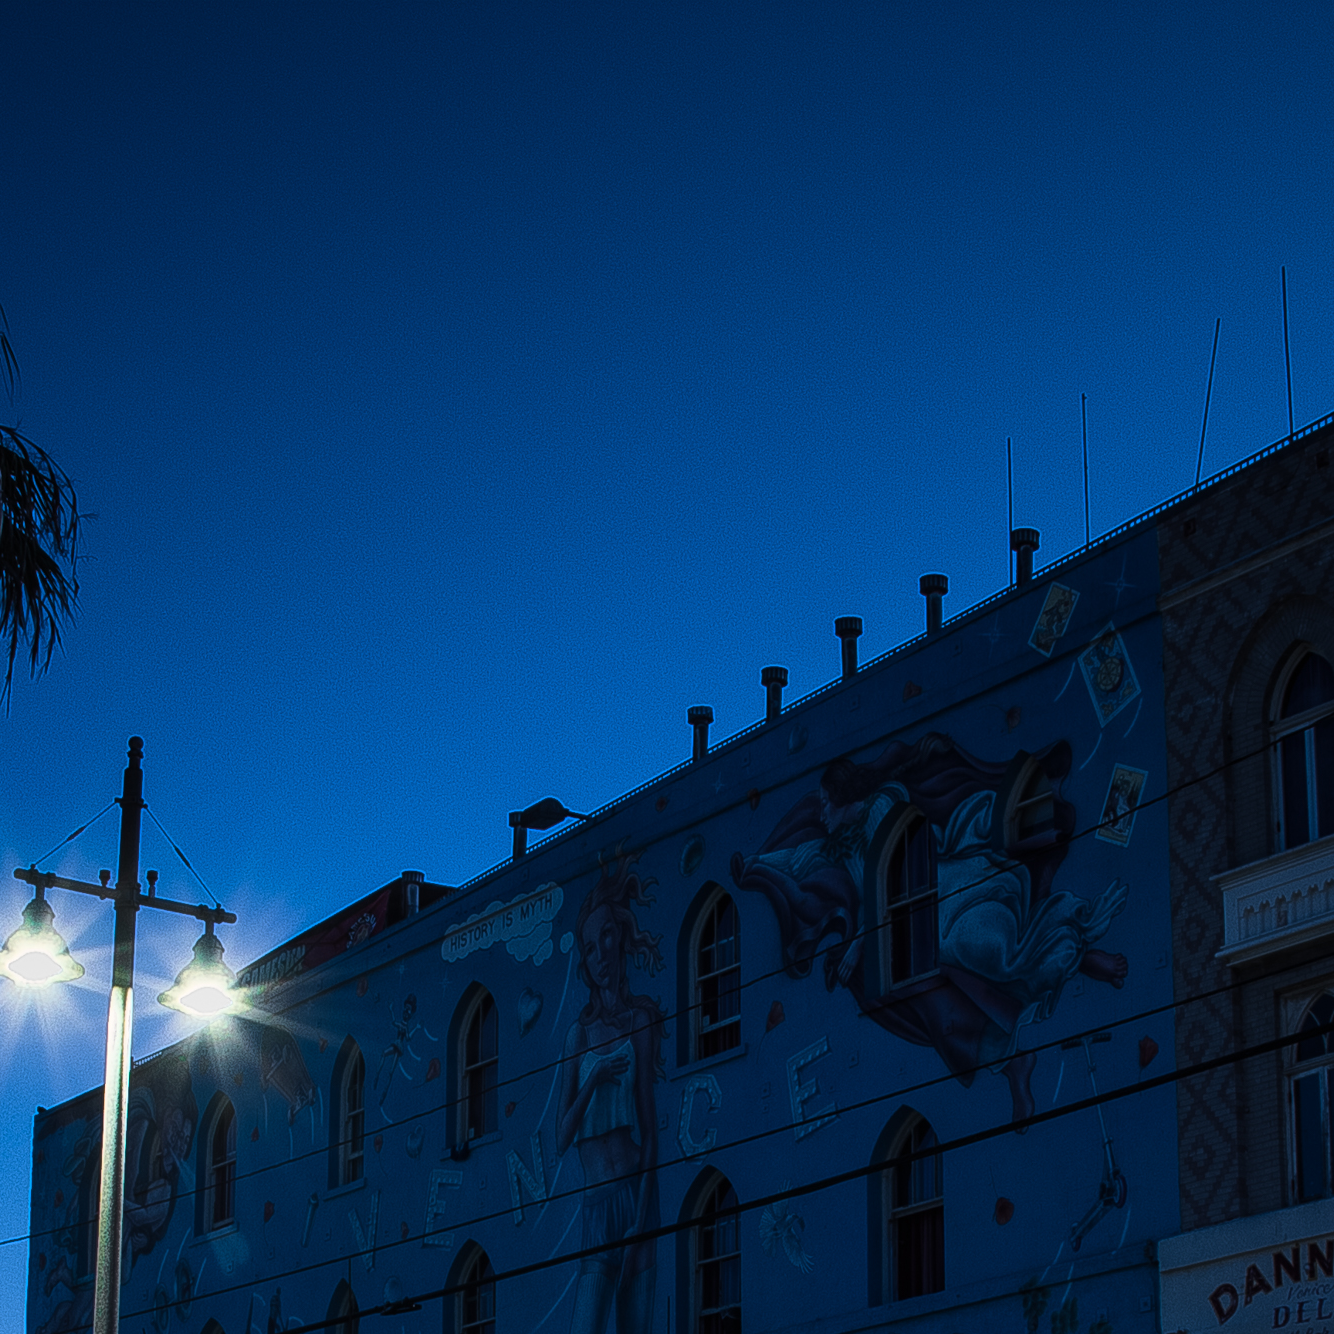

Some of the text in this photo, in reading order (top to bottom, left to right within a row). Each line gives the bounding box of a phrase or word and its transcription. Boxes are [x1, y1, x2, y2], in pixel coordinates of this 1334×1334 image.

[450, 893, 552, 952] HISTORY IS MYTH
[1287, 1283, 1334, 1300] Venice
